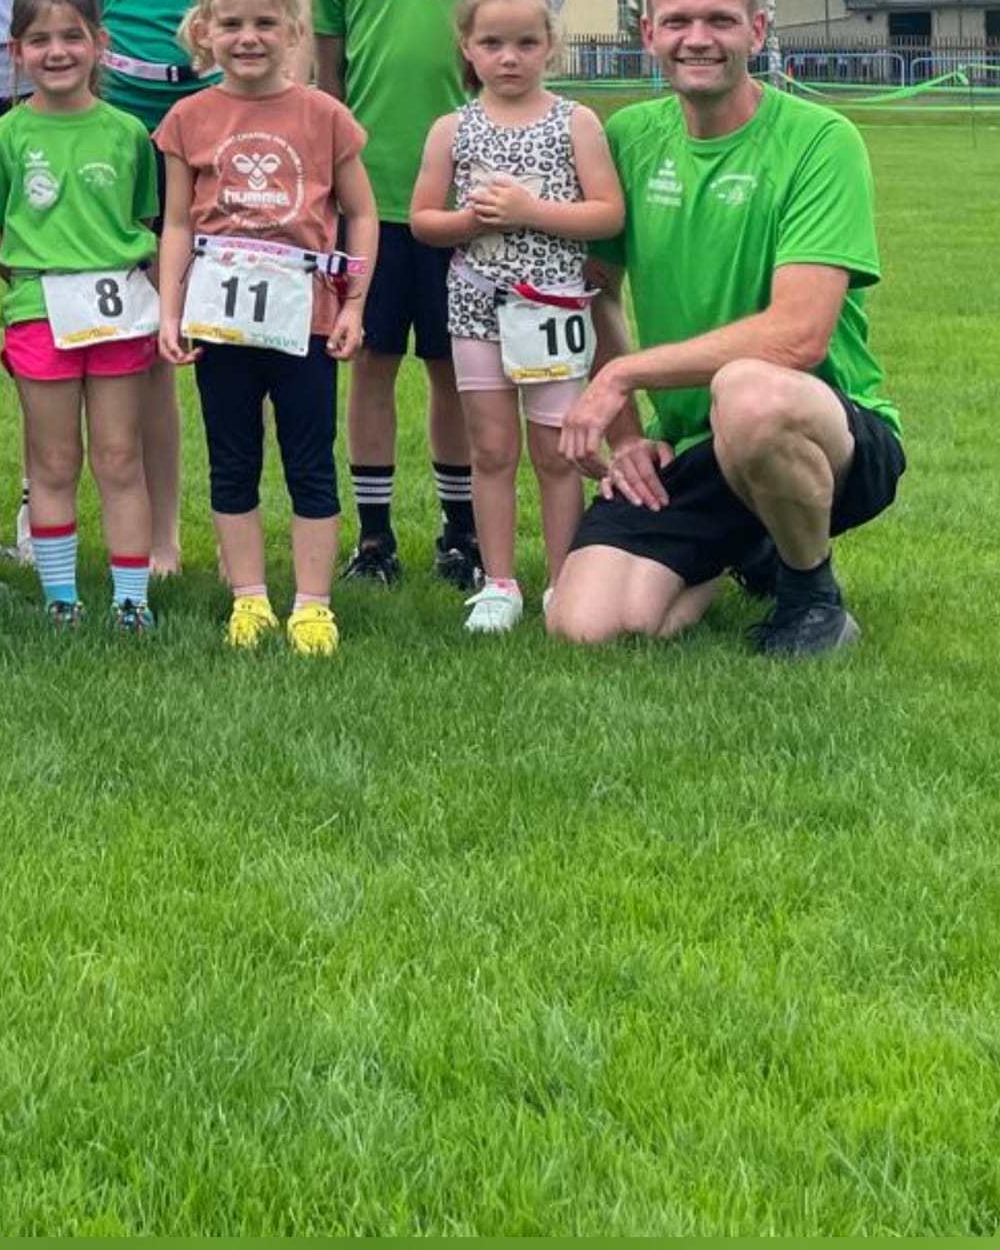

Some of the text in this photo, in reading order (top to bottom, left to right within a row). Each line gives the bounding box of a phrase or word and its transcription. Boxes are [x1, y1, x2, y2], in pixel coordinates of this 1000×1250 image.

[95, 278, 123, 317] 8
[221, 276, 268, 322] 11
[539, 315, 585, 356] 10
